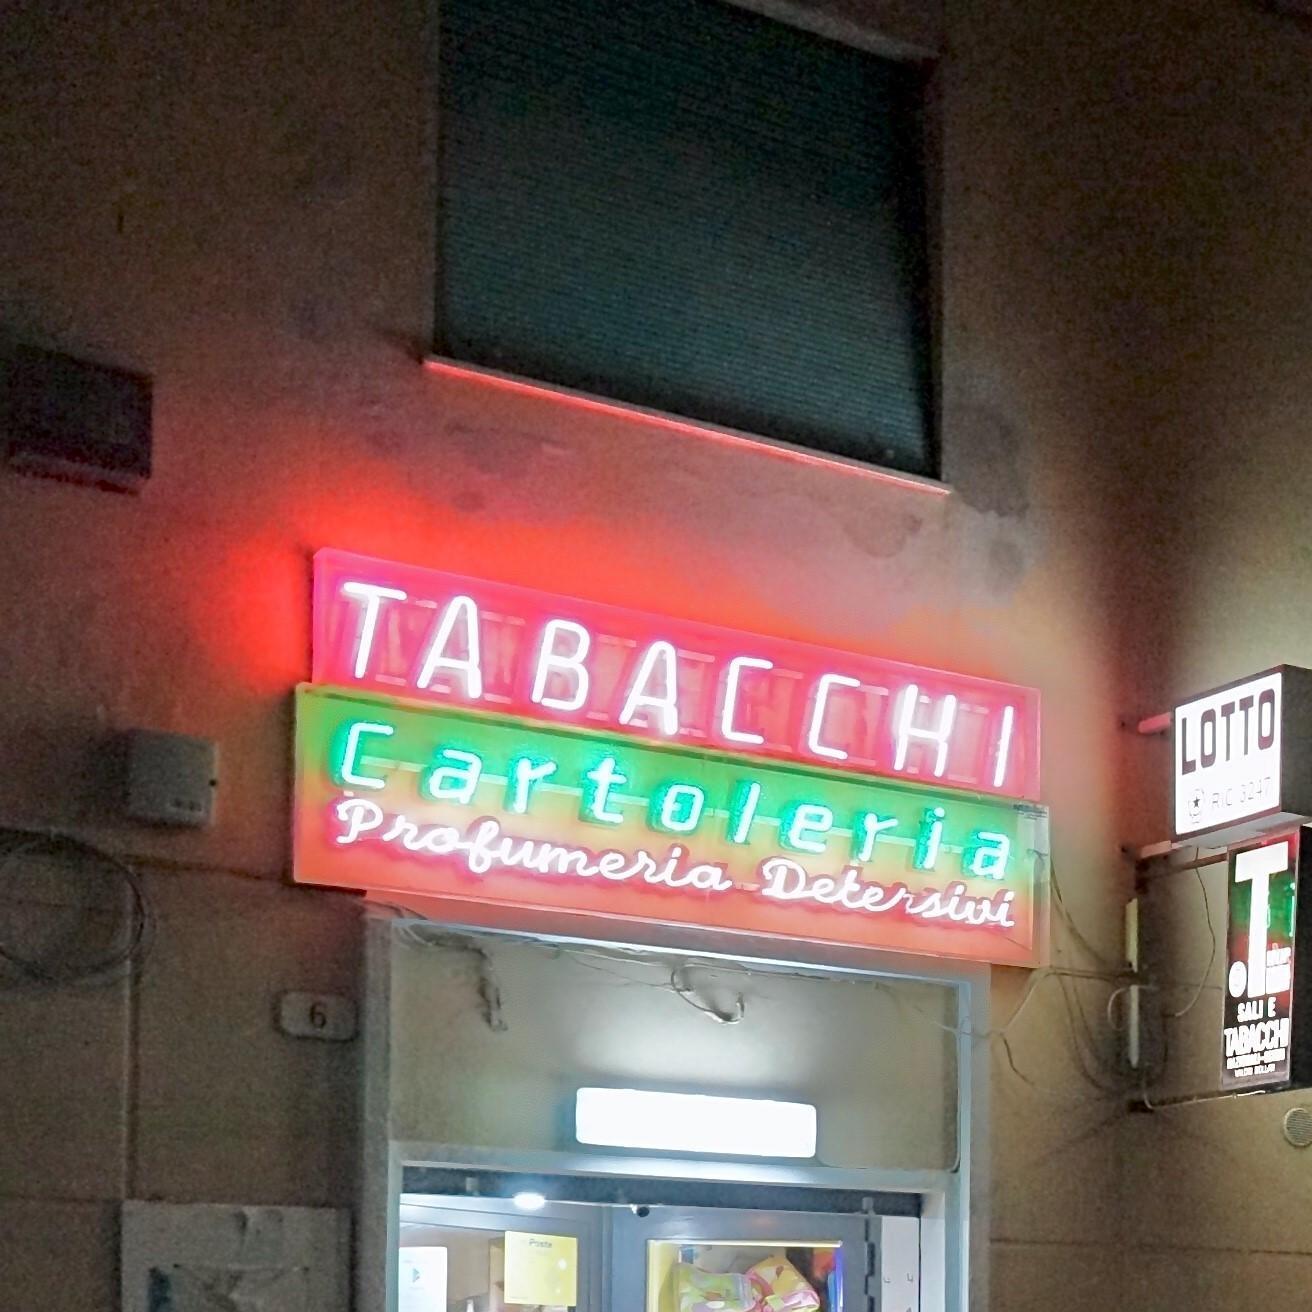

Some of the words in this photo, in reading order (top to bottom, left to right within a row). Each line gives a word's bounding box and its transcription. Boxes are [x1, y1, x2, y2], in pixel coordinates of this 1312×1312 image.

[340, 579, 1016, 789] TABACCHI
[1181, 688, 1275, 776] LOTTO
[337, 720, 1012, 882] Cartoleria
[335, 796, 734, 894] Profumeria
[760, 854, 1018, 929] Detersivi
[309, 1001, 327, 1029] 6
[1224, 1017, 1290, 1058] TABACCHI
[1237, 1000, 1264, 1023] SALI
[1267, 996, 1277, 1018] E
